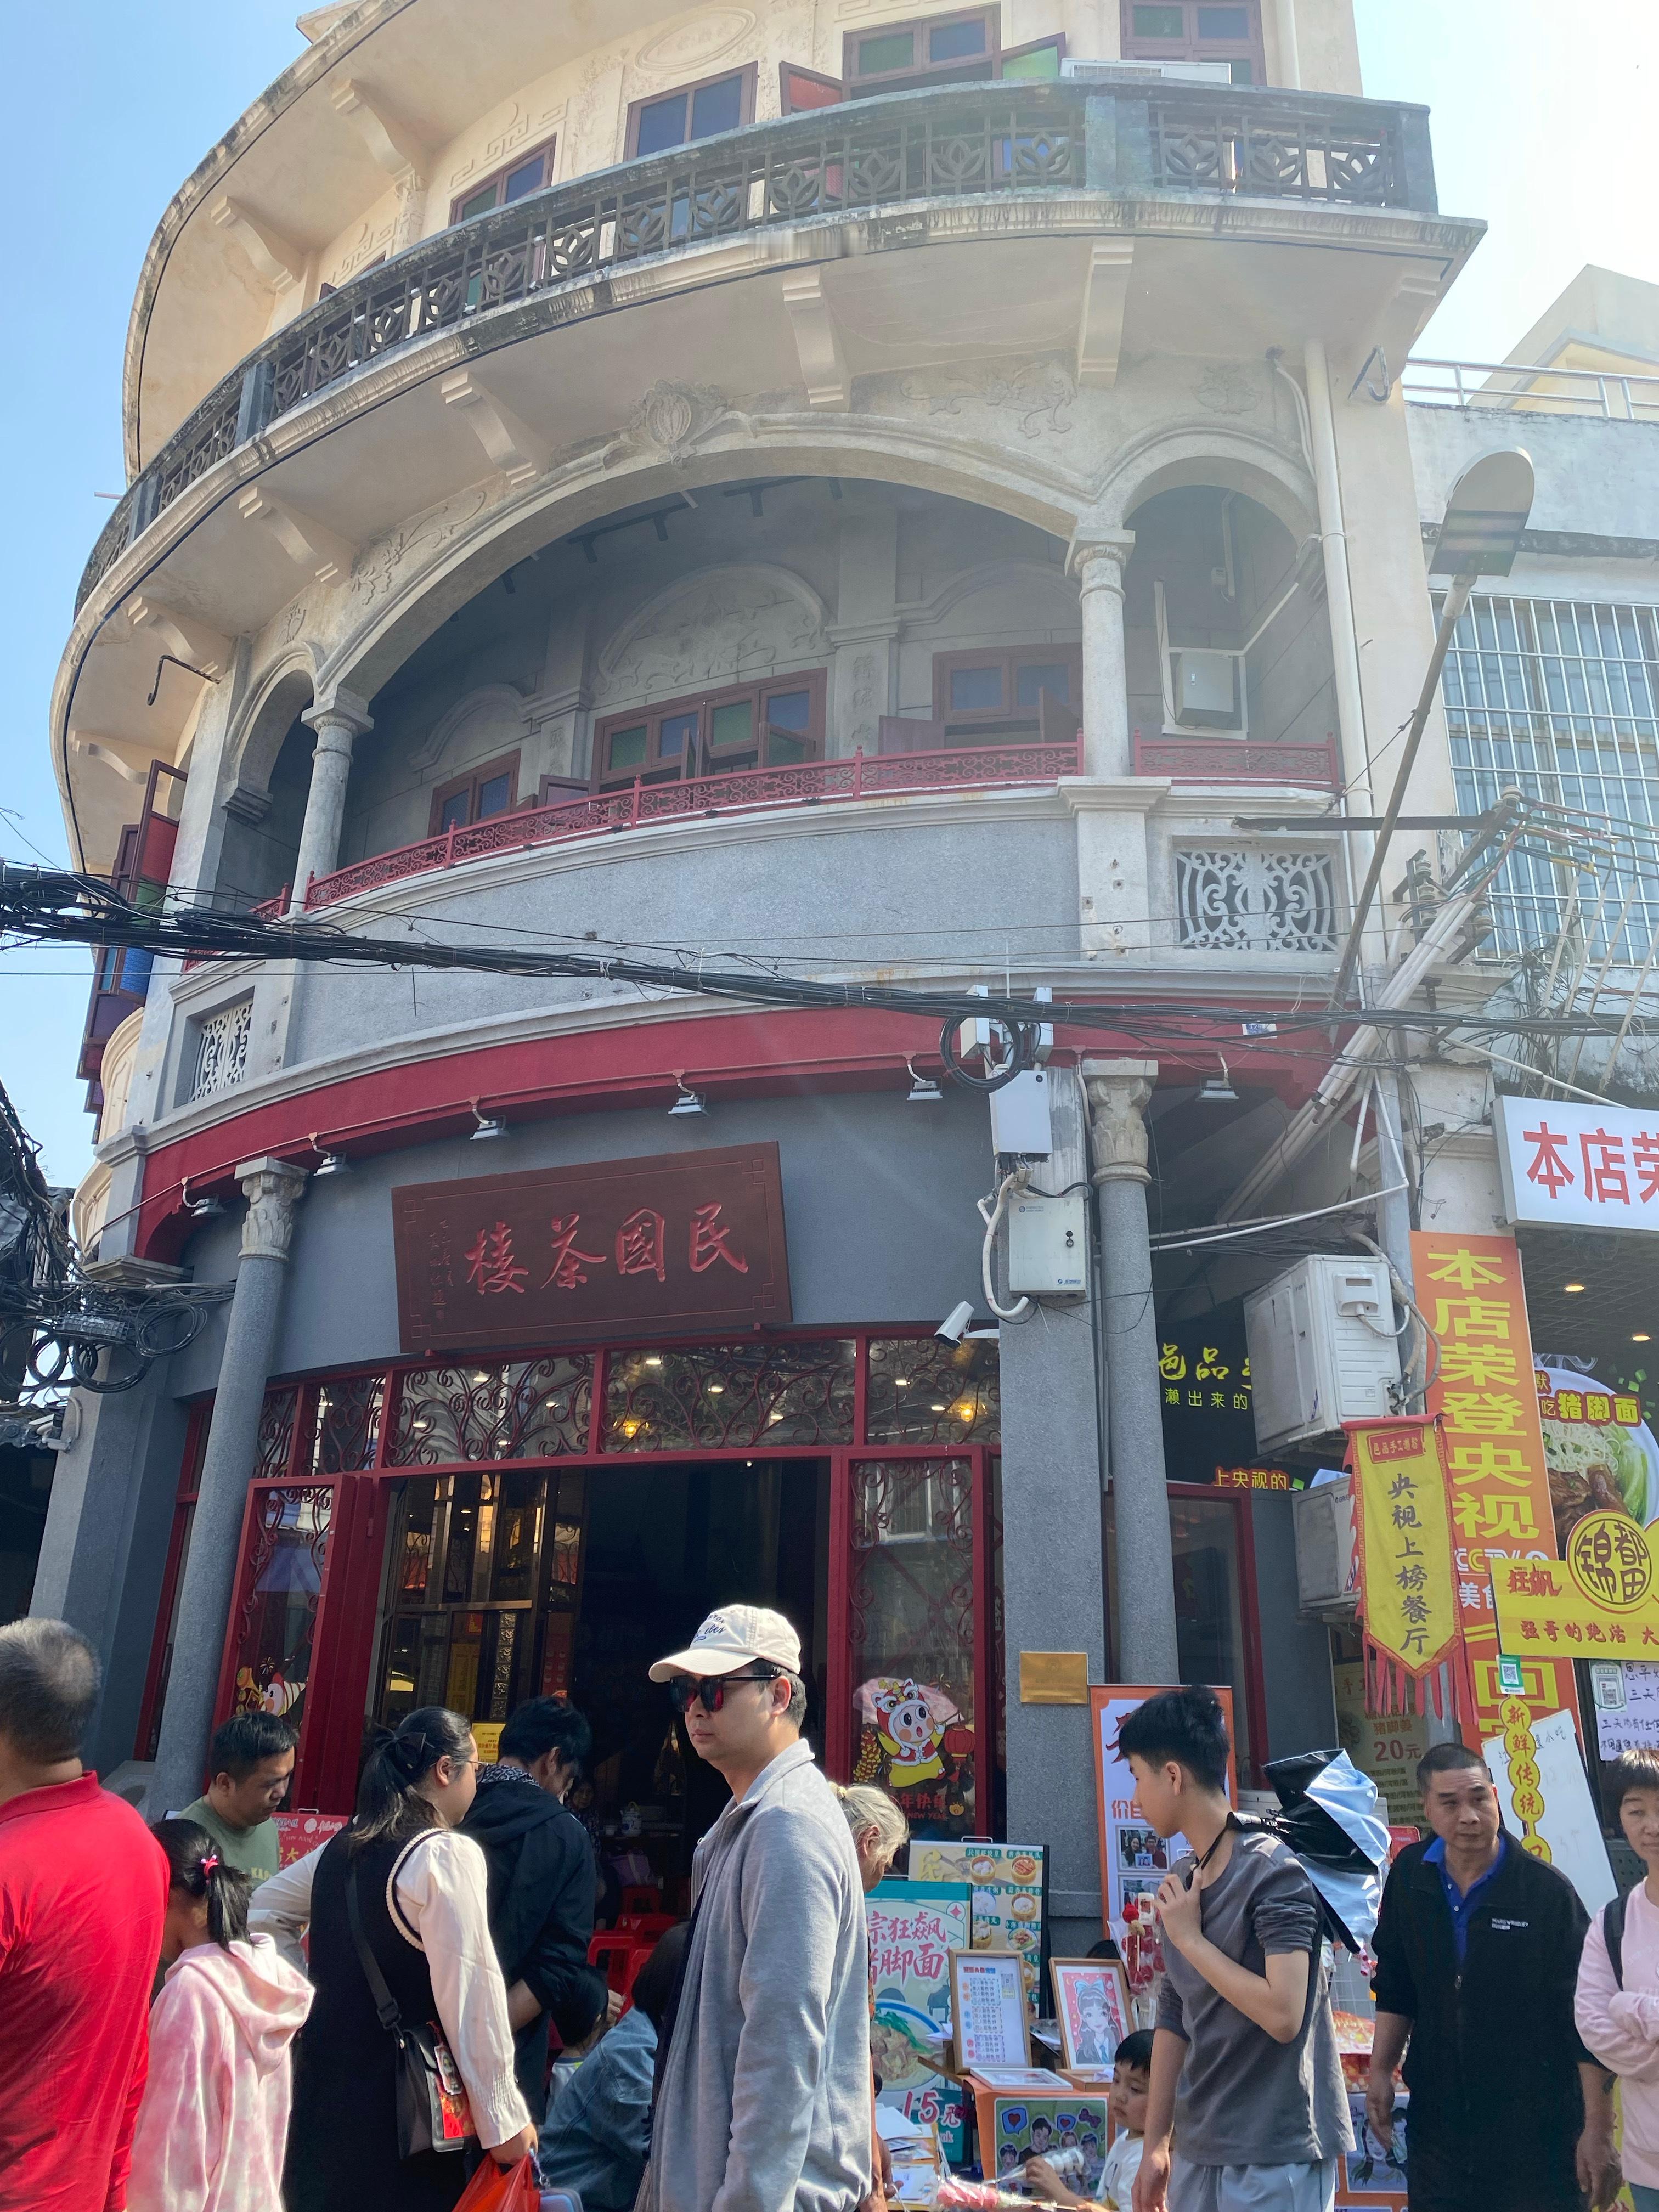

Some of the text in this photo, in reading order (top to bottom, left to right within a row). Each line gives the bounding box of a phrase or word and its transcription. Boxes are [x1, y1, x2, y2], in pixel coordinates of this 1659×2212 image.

[1159, 1342, 1252, 1390] 邑品
[1165, 1387, 1248, 1410] 濑出来的
[1426, 1249, 1539, 1539] 本店荣登央视
[1214, 1469, 1287, 1491] 上央视的
[1387, 1472, 1432, 1656] 央视上榜餐厅
[1521, 1620, 1626, 1643] 强哥的绝活
[1373, 1739, 1423, 1762] 20元
